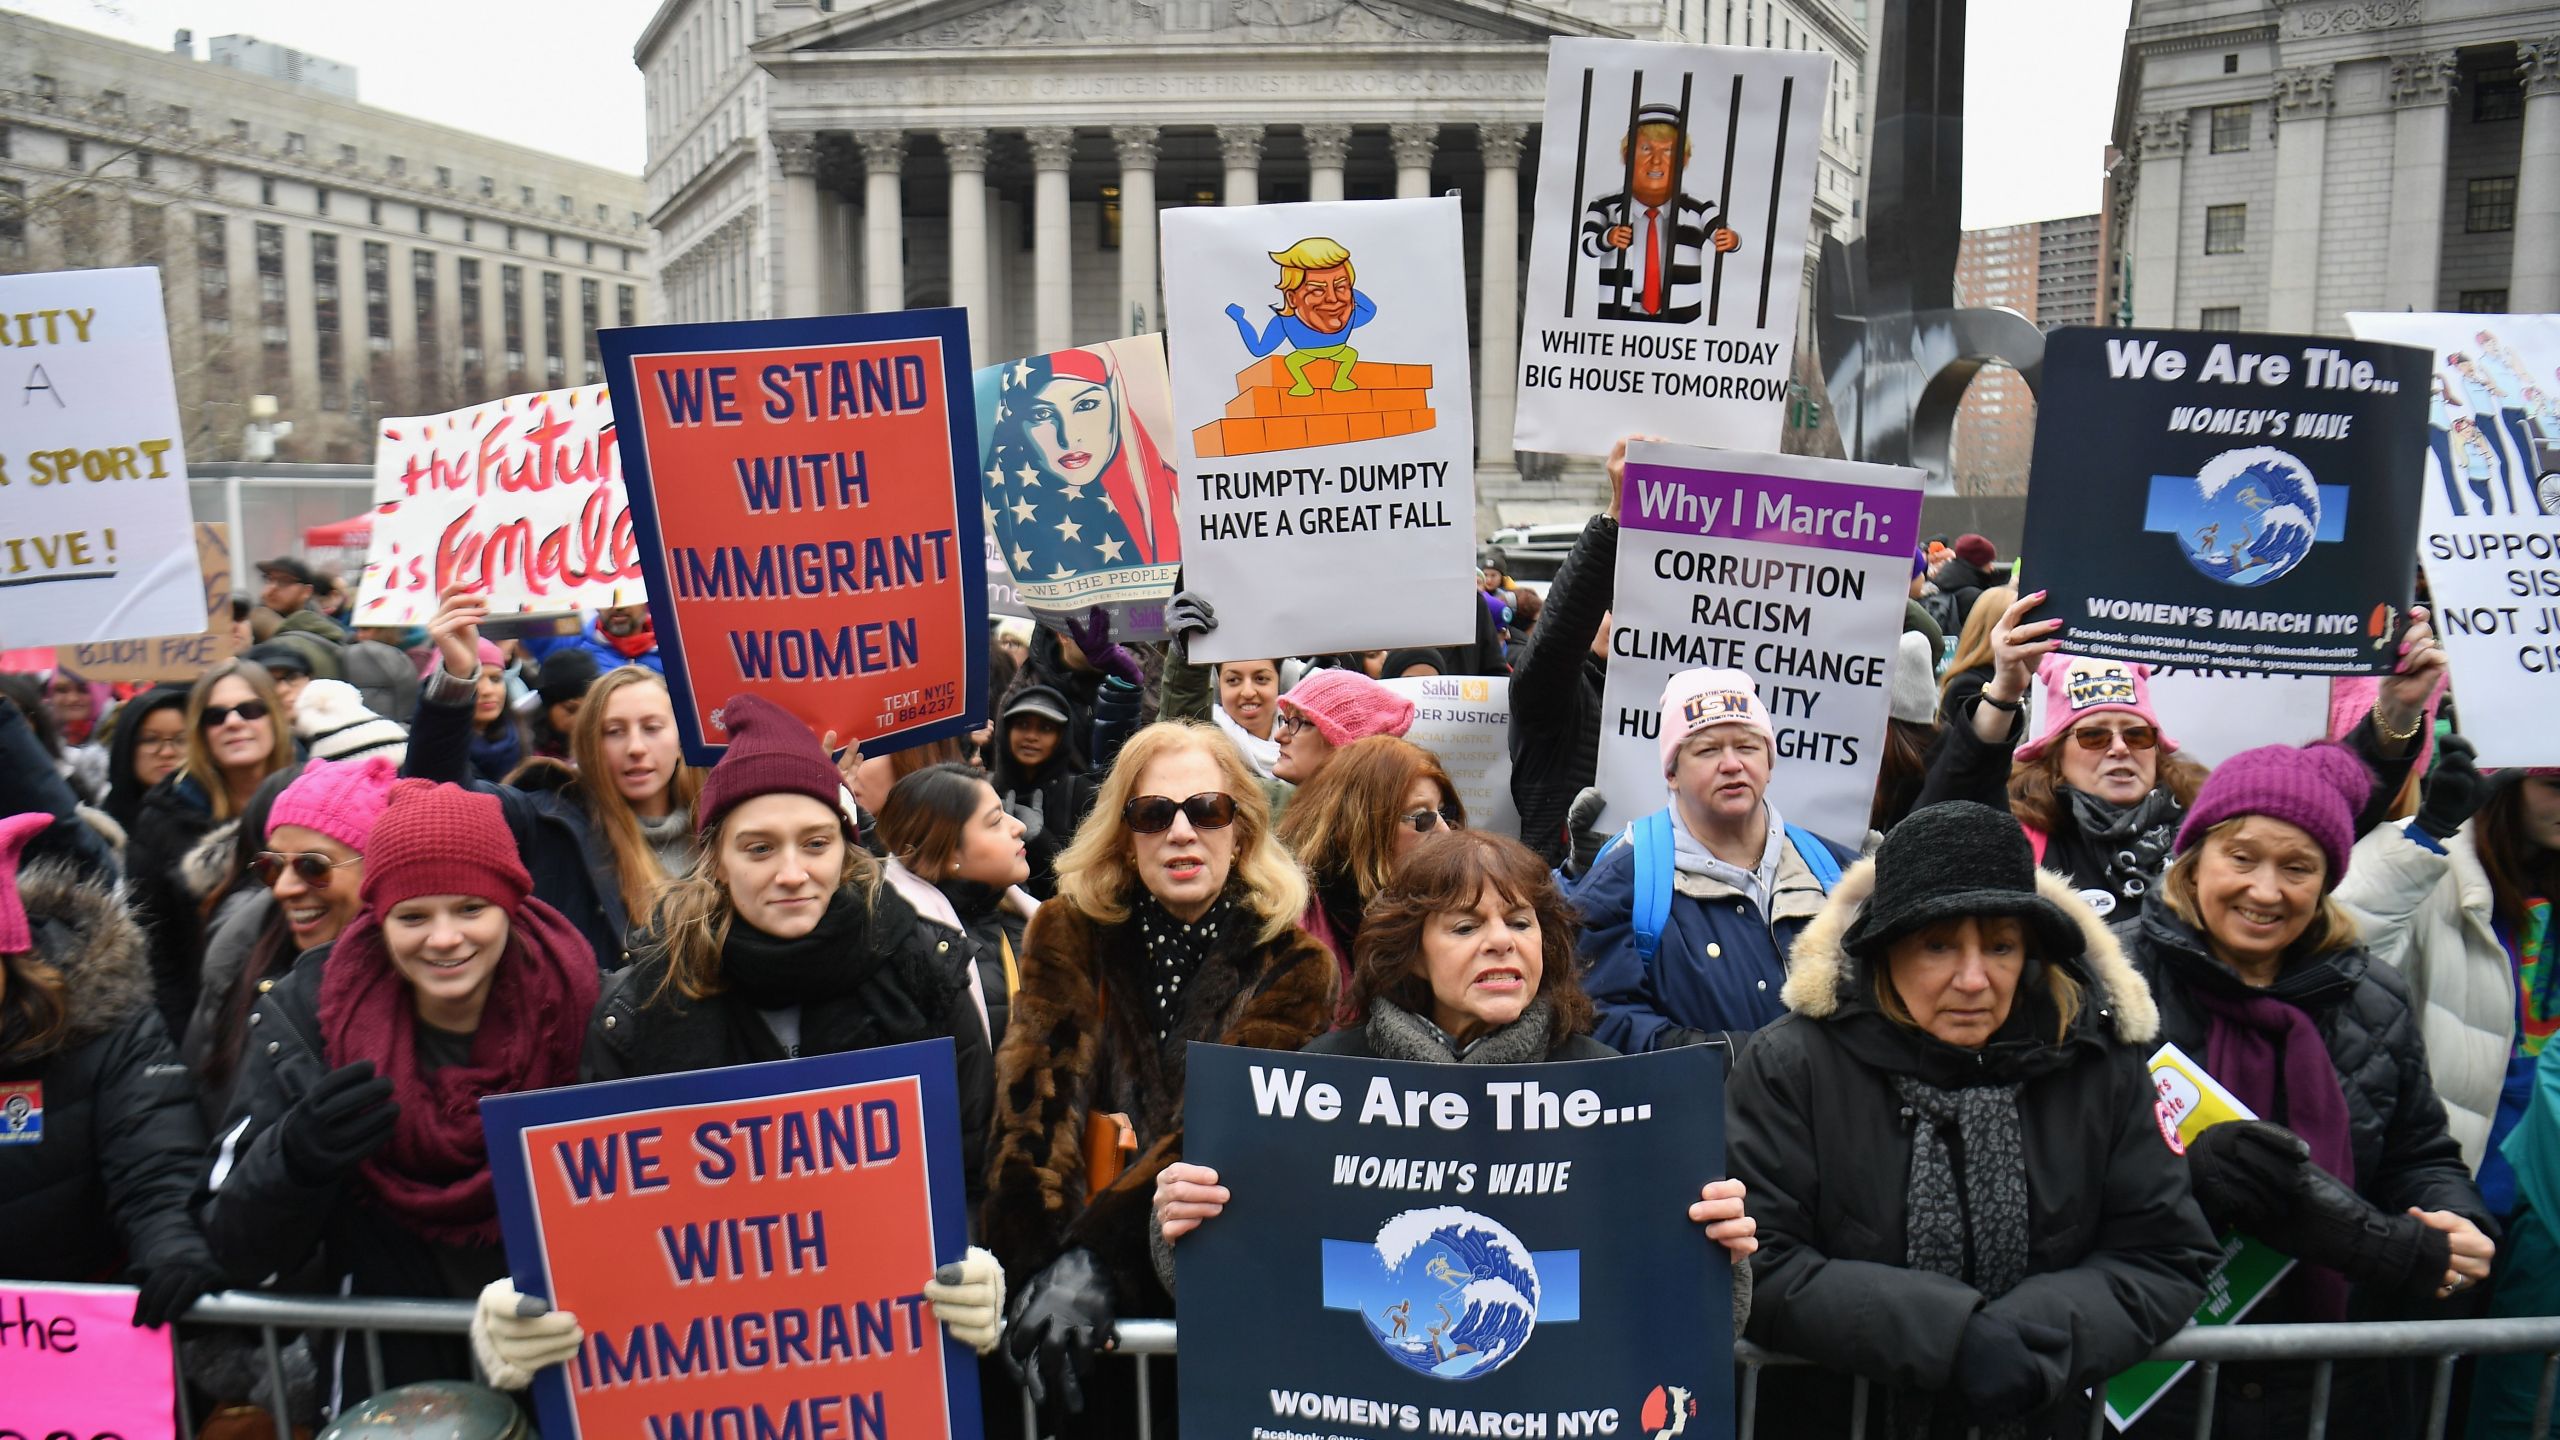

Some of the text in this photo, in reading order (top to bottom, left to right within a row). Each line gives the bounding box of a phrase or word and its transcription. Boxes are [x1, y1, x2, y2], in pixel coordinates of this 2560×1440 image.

[1069, 77, 1144, 95] JUSTICE
[1174, 76, 1209, 94] THE
[1215, 75, 1289, 93] FIRMEST
[1395, 74, 1451, 92] GOOD
[1541, 330, 1779, 365] WHITE HOUSE TODAY
[2105, 337, 2400, 394] We Are The...
[23, 364, 66, 408] A
[655, 354, 928, 428] WE STAND
[1525, 365, 1789, 402] BIG HOUSE TOMORROW
[2167, 406, 2353, 440] WOMEN'S WAVE
[28, 438, 173, 486] SPORT
[400, 404, 626, 497] the Futur
[733, 450, 870, 516] WITH
[1197, 461, 1449, 501] TRUMPTY- DUMPTY
[1200, 501, 1452, 541] HAVE A GREAT FALL
[1637, 479, 1893, 544] Why I March:
[0, 528, 116, 573] IVE!
[386, 482, 642, 600] is Female
[2430, 533, 2560, 561] SUPPO
[670, 528, 953, 601] IMMIGRANT
[1033, 568, 1170, 597] WE THE PEOPLE
[1654, 548, 1865, 601] CORRUPTION
[1691, 594, 1811, 637] RACISM
[2086, 597, 2359, 636] WOMEN'S MARCH NYC
[2444, 607, 2520, 636] NOT
[727, 617, 920, 682] WOMEN
[1613, 627, 1886, 688] CLIMATE CHANGE
[2067, 626, 2129, 644] Facebook:
[2130, 633, 2186, 650] @NYCWM
[2187, 638, 2252, 656] Instagram:
[2518, 645, 2560, 674] CI
[2211, 655, 2263, 669] website:
[884, 681, 955, 711] TEXT NYIC
[1422, 680, 1459, 697] Sakhi
[1683, 694, 1750, 722] USW
[876, 696, 955, 729] TO 864237
[1414, 708, 1509, 725] DER JUSTICE
[1249, 1065, 1652, 1131] We Are The...
[552, 1098, 902, 1206] WE STAND
[1333, 1155, 1572, 1195] WOMEN'S WAVE
[657, 1209, 829, 1288] WITH
[576, 1292, 928, 1395] IMMIGRANT
[1270, 1389, 1620, 1438] WOMEN'S MARCH NYC
